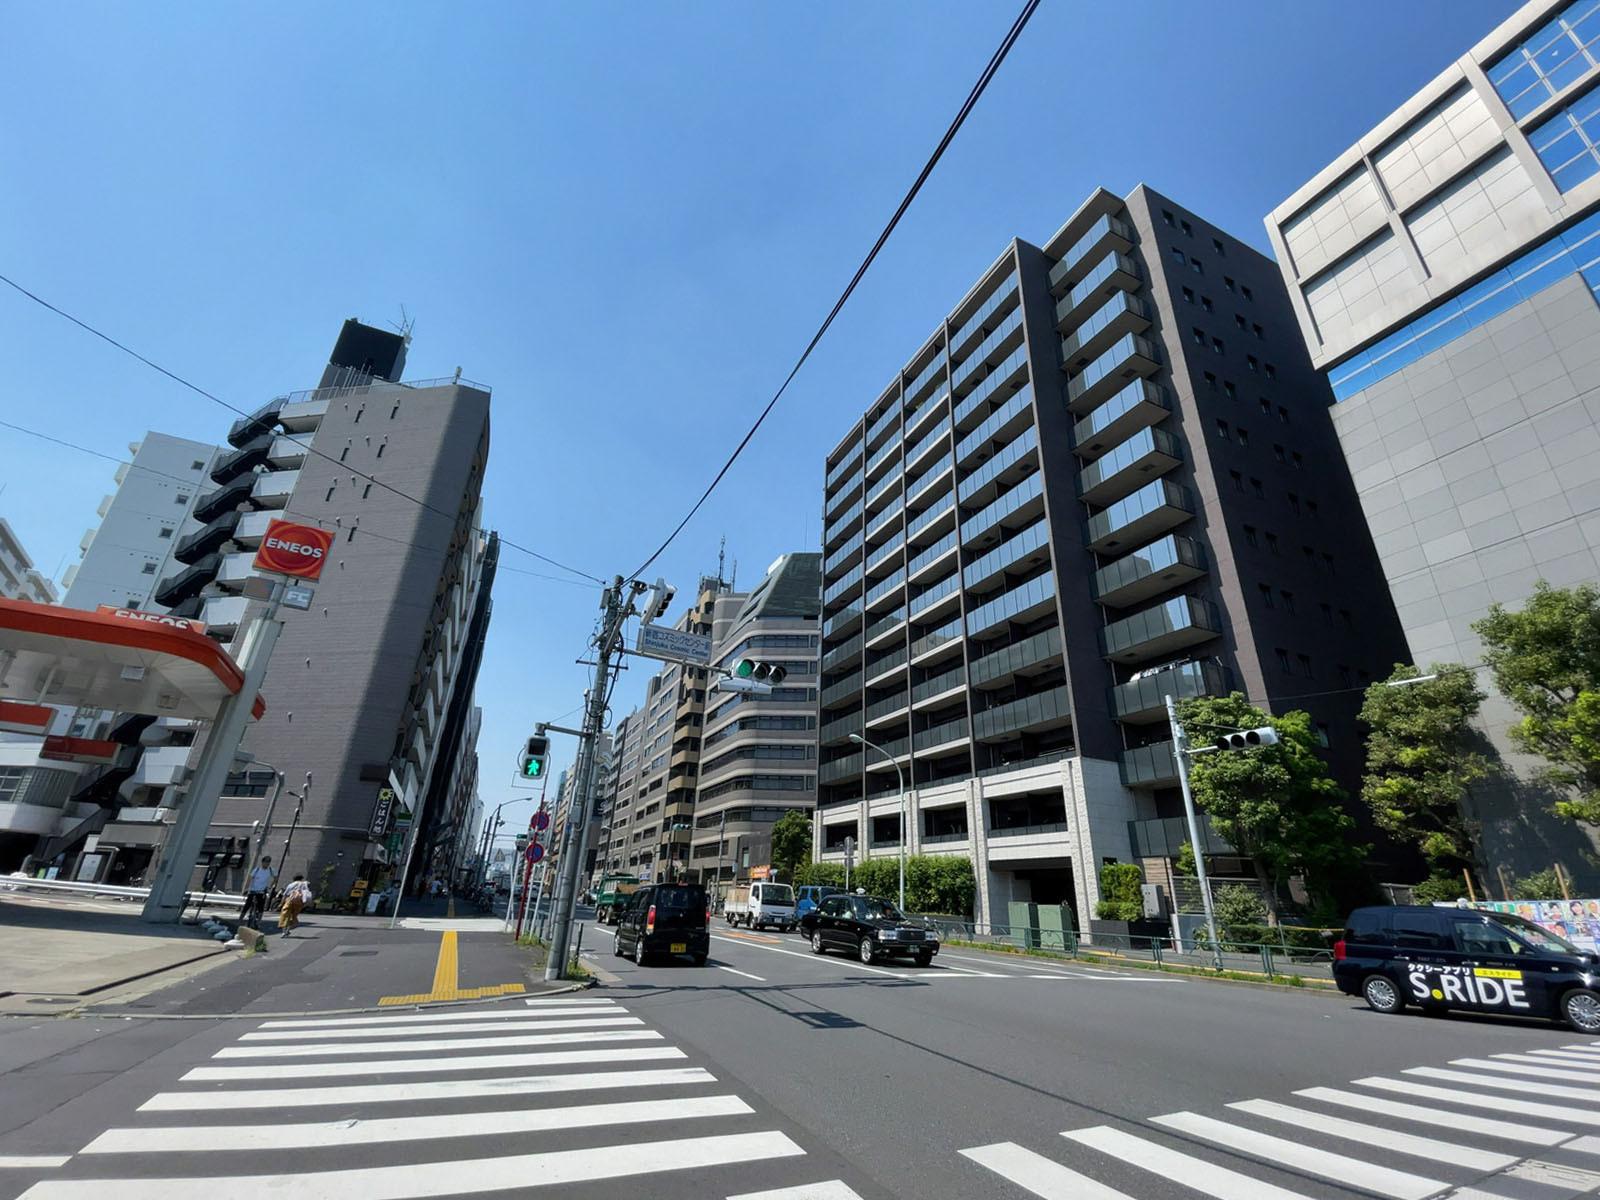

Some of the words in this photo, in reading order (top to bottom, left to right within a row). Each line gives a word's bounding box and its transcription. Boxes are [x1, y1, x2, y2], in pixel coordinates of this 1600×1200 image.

[266, 538, 323, 558] ENEOS
[1408, 963, 1471, 976] タクシーアプリ
